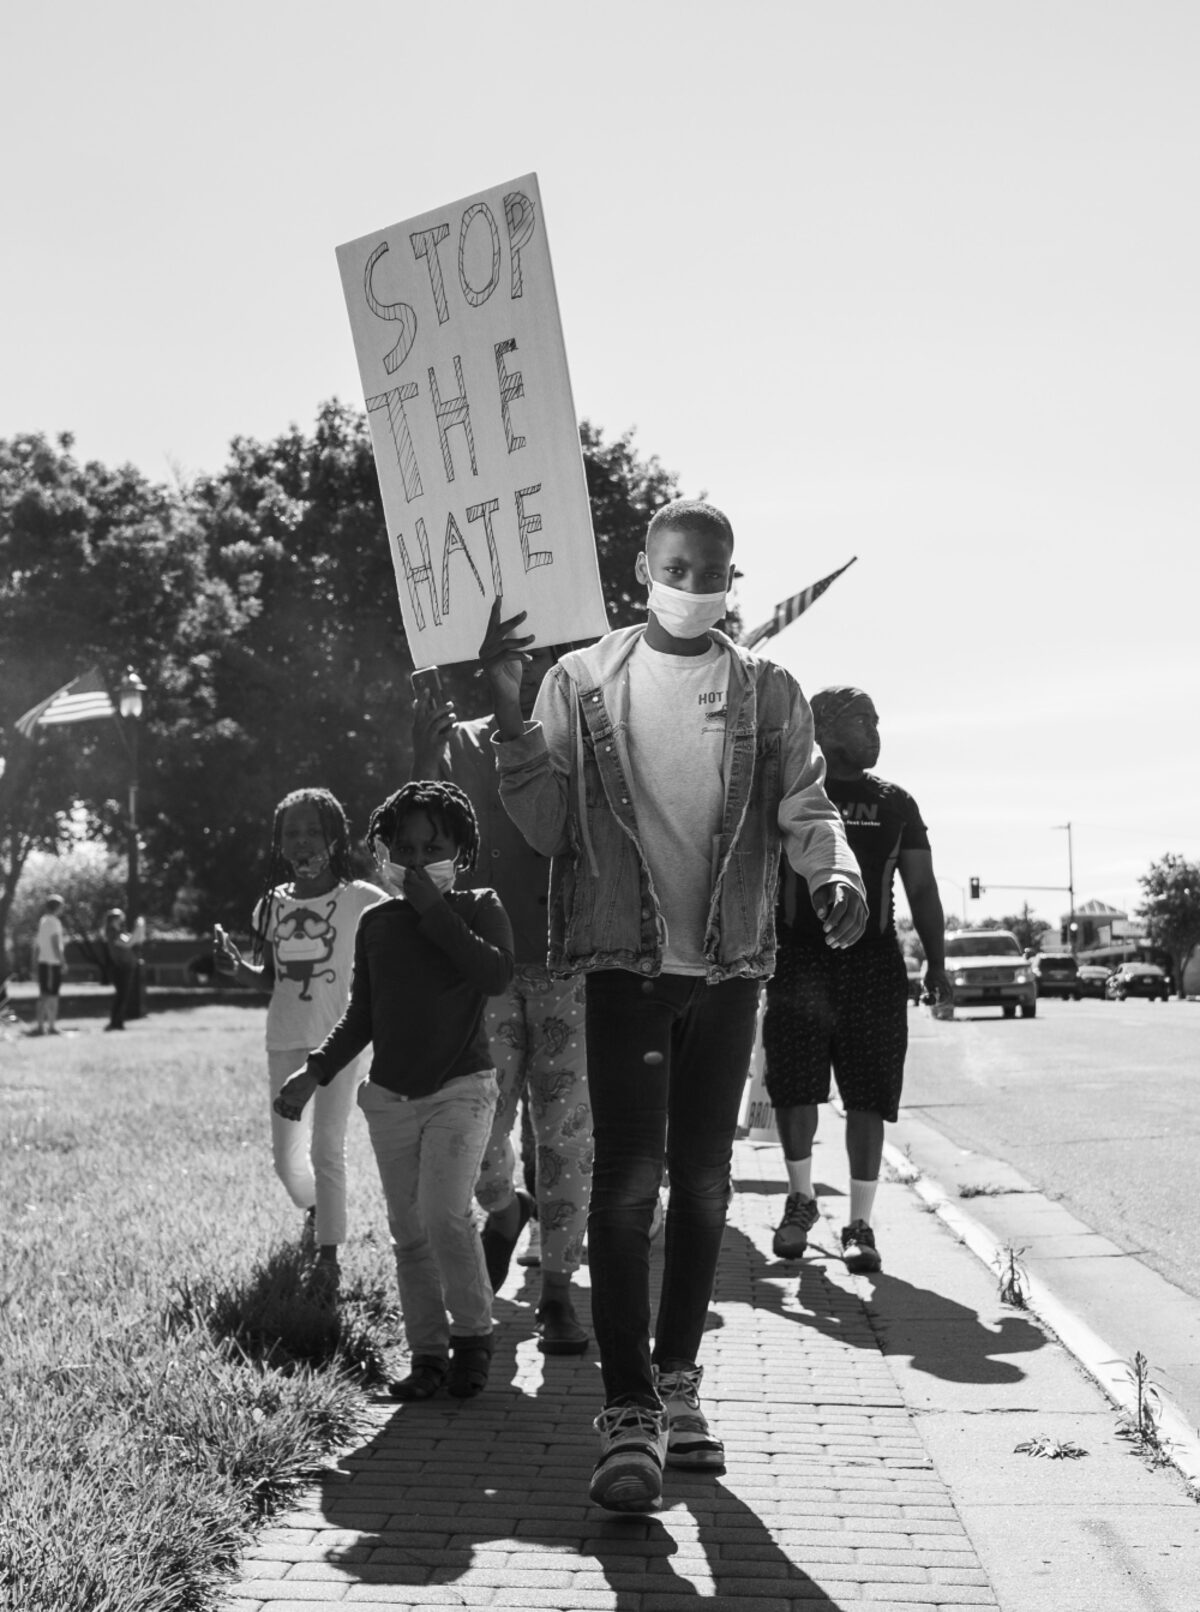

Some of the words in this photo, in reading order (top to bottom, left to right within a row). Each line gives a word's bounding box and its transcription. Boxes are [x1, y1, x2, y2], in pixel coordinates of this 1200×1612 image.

[365, 191, 535, 375] STOP
[366, 338, 526, 503] THE
[397, 483, 553, 631] HATE
[698, 691, 724, 705] HOT
